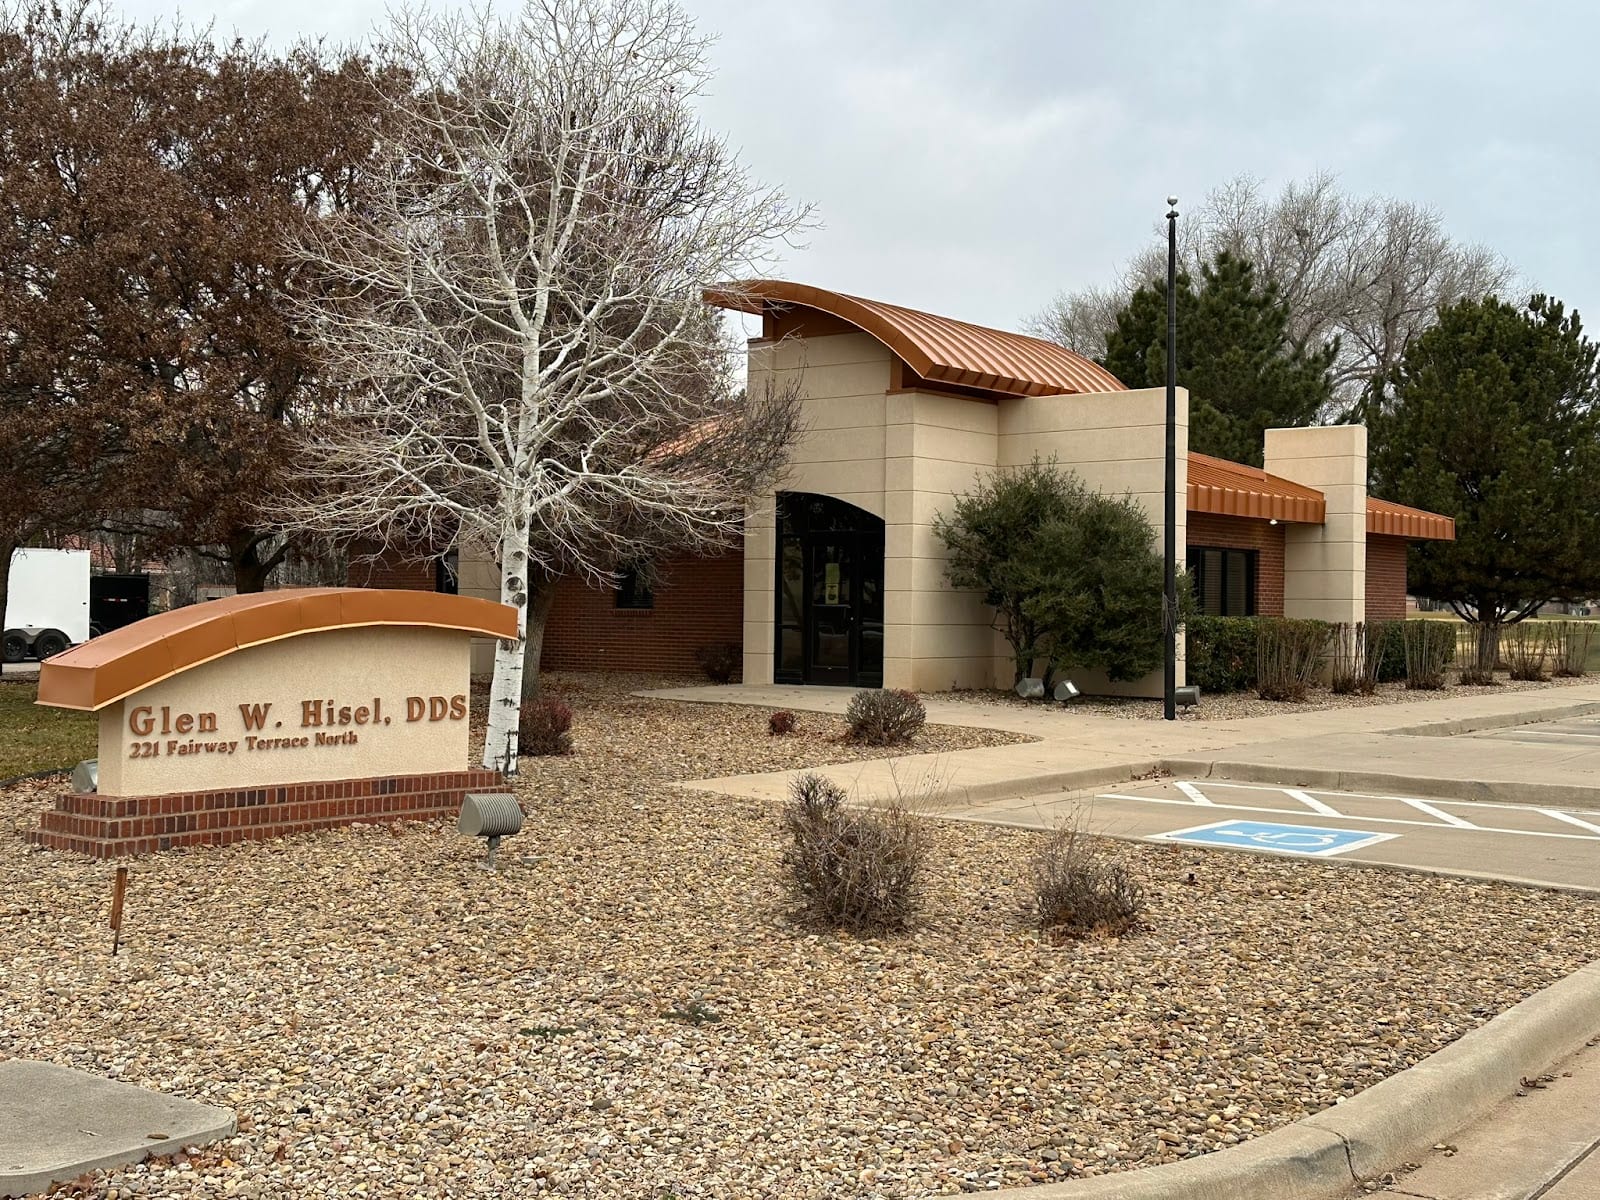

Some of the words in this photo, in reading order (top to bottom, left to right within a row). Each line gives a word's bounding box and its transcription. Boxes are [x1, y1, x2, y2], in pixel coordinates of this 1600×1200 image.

[129, 705, 218, 736] Glen
[239, 703, 282, 730] W.
[301, 697, 391, 727] Hisel,
[406, 694, 467, 722] DDS
[129, 742, 161, 758] 221
[167, 738, 239, 756] Fairway
[245, 734, 309, 752] Terrace
[314, 731, 358, 747] North
